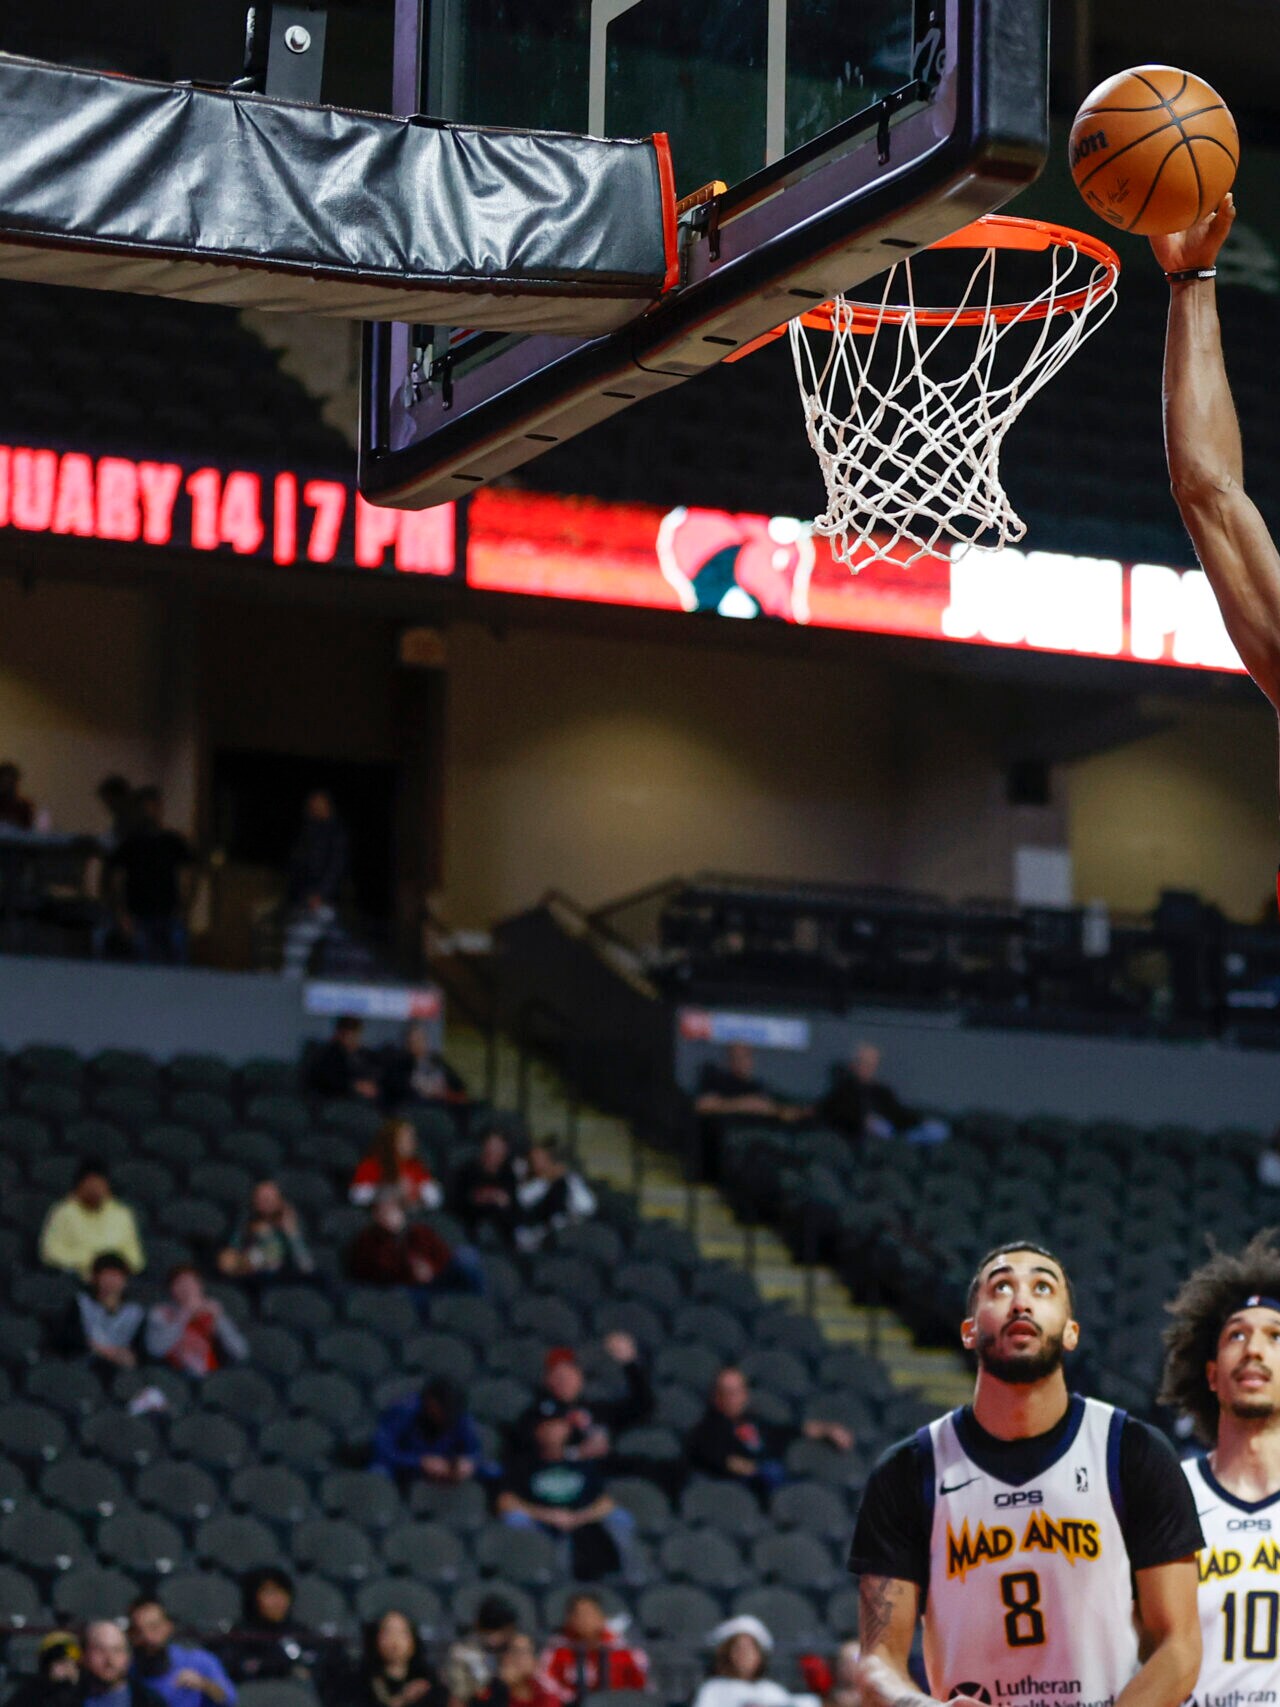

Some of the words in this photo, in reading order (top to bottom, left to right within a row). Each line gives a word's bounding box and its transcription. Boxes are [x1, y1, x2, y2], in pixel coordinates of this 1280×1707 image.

[186, 467, 264, 556] 14
[303, 479, 347, 564] 7
[354, 490, 457, 577] PM
[994, 1490, 1043, 1507] OPS
[947, 1516, 1013, 1584] MAD
[1020, 1508, 1100, 1566] ANTS
[1227, 1519, 1271, 1531] OPS
[1000, 1570, 1046, 1647] 8
[1221, 1590, 1280, 1663] 10
[995, 1675, 1081, 1697] Lutheran
[1205, 1690, 1277, 1707] Luthran
